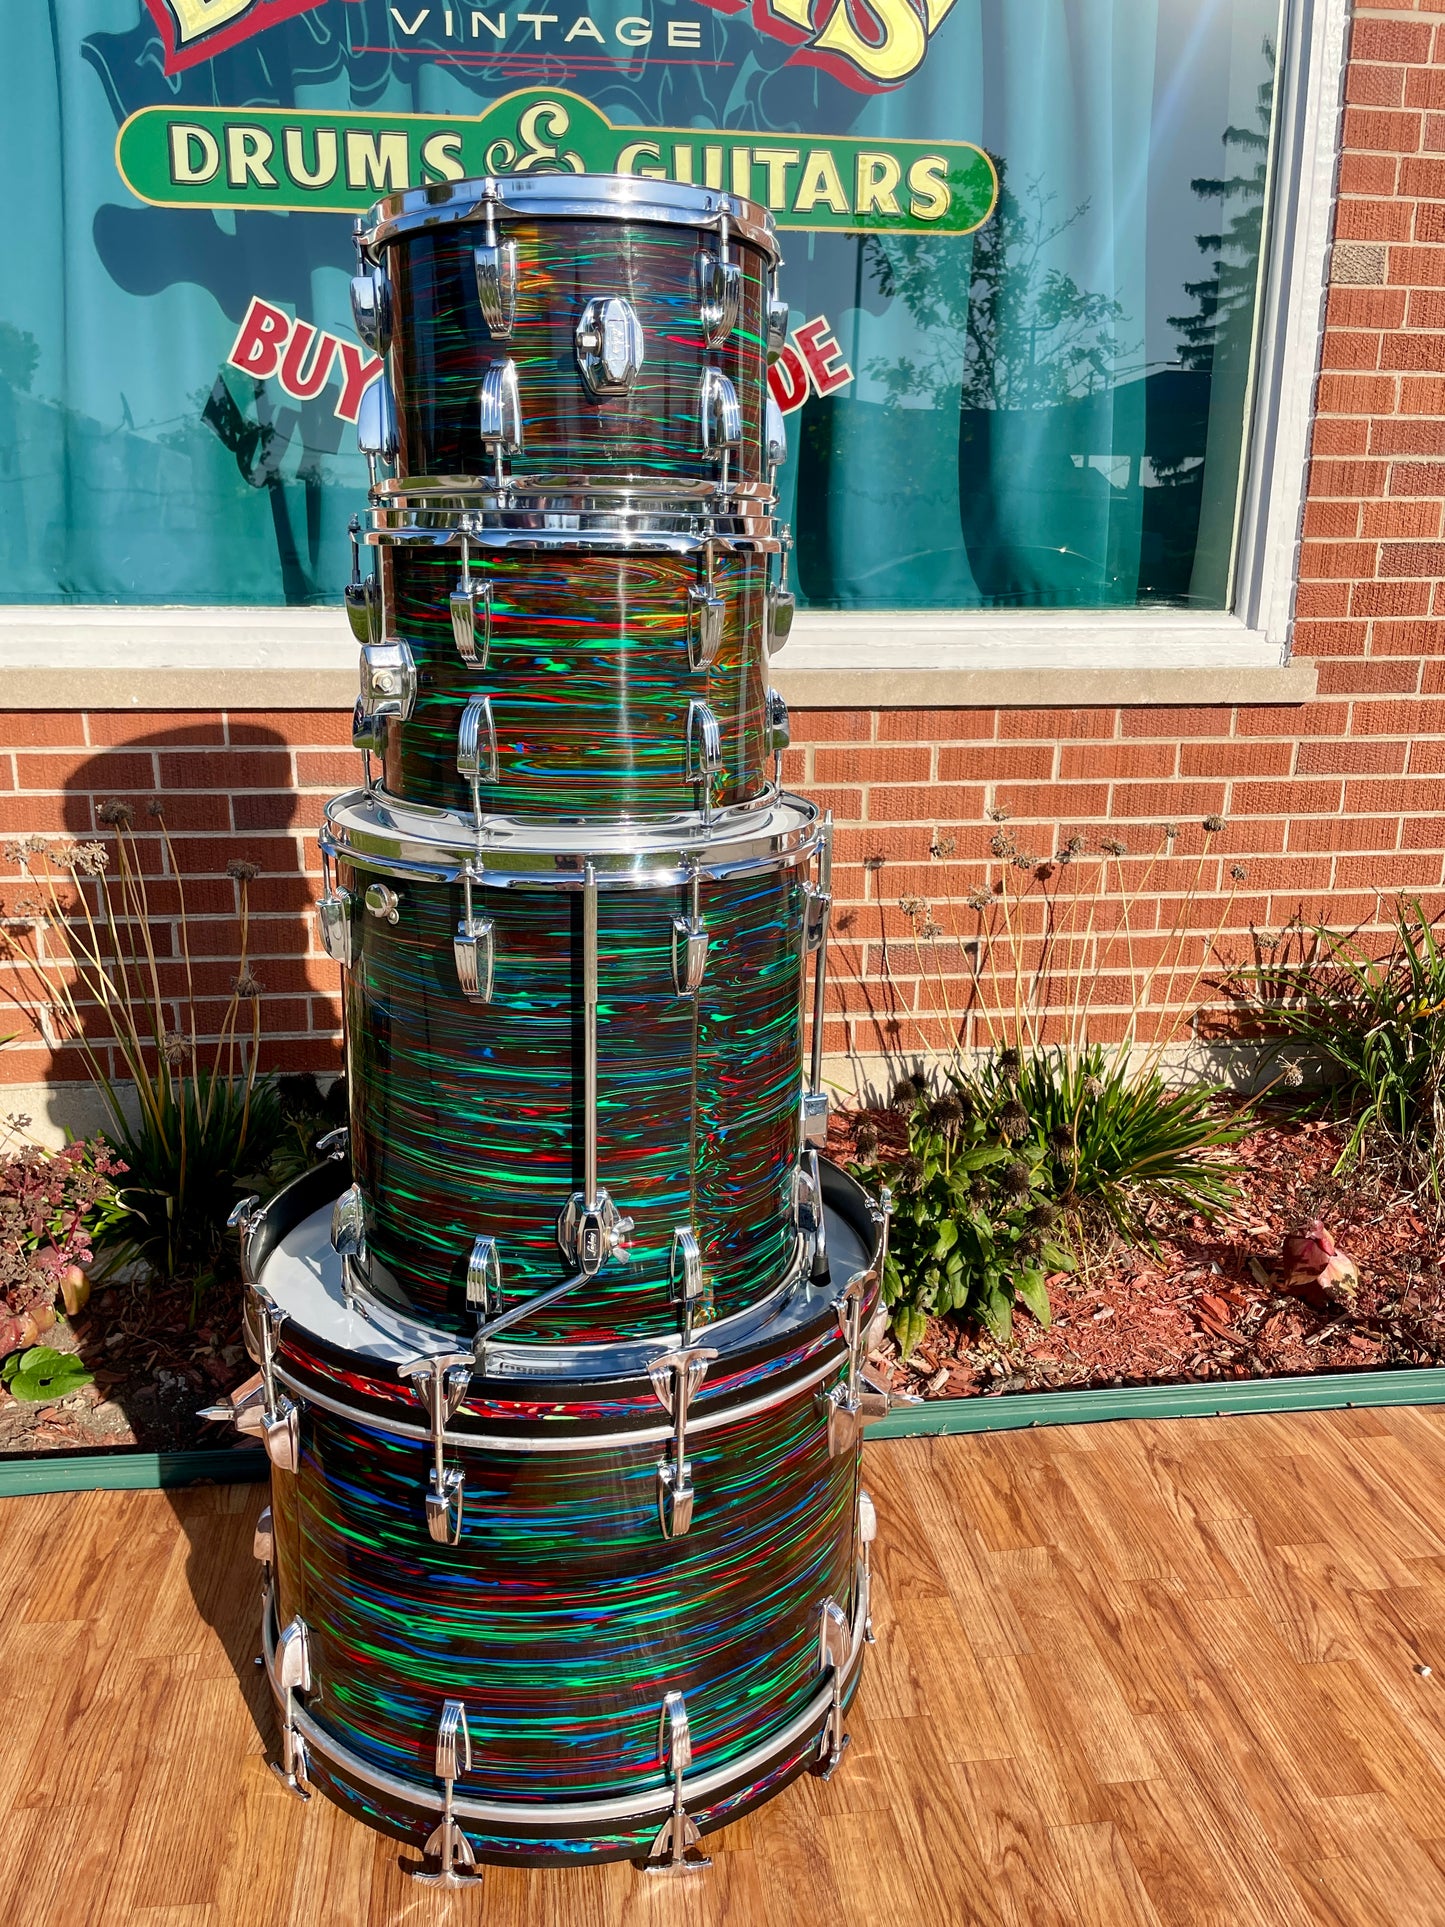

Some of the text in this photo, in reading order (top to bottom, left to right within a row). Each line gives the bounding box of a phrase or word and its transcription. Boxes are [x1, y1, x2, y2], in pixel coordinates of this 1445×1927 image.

[390, 8, 701, 48] VINTAGE
[167, 120, 466, 191] DRUMS
[227, 296, 384, 425] BUY
